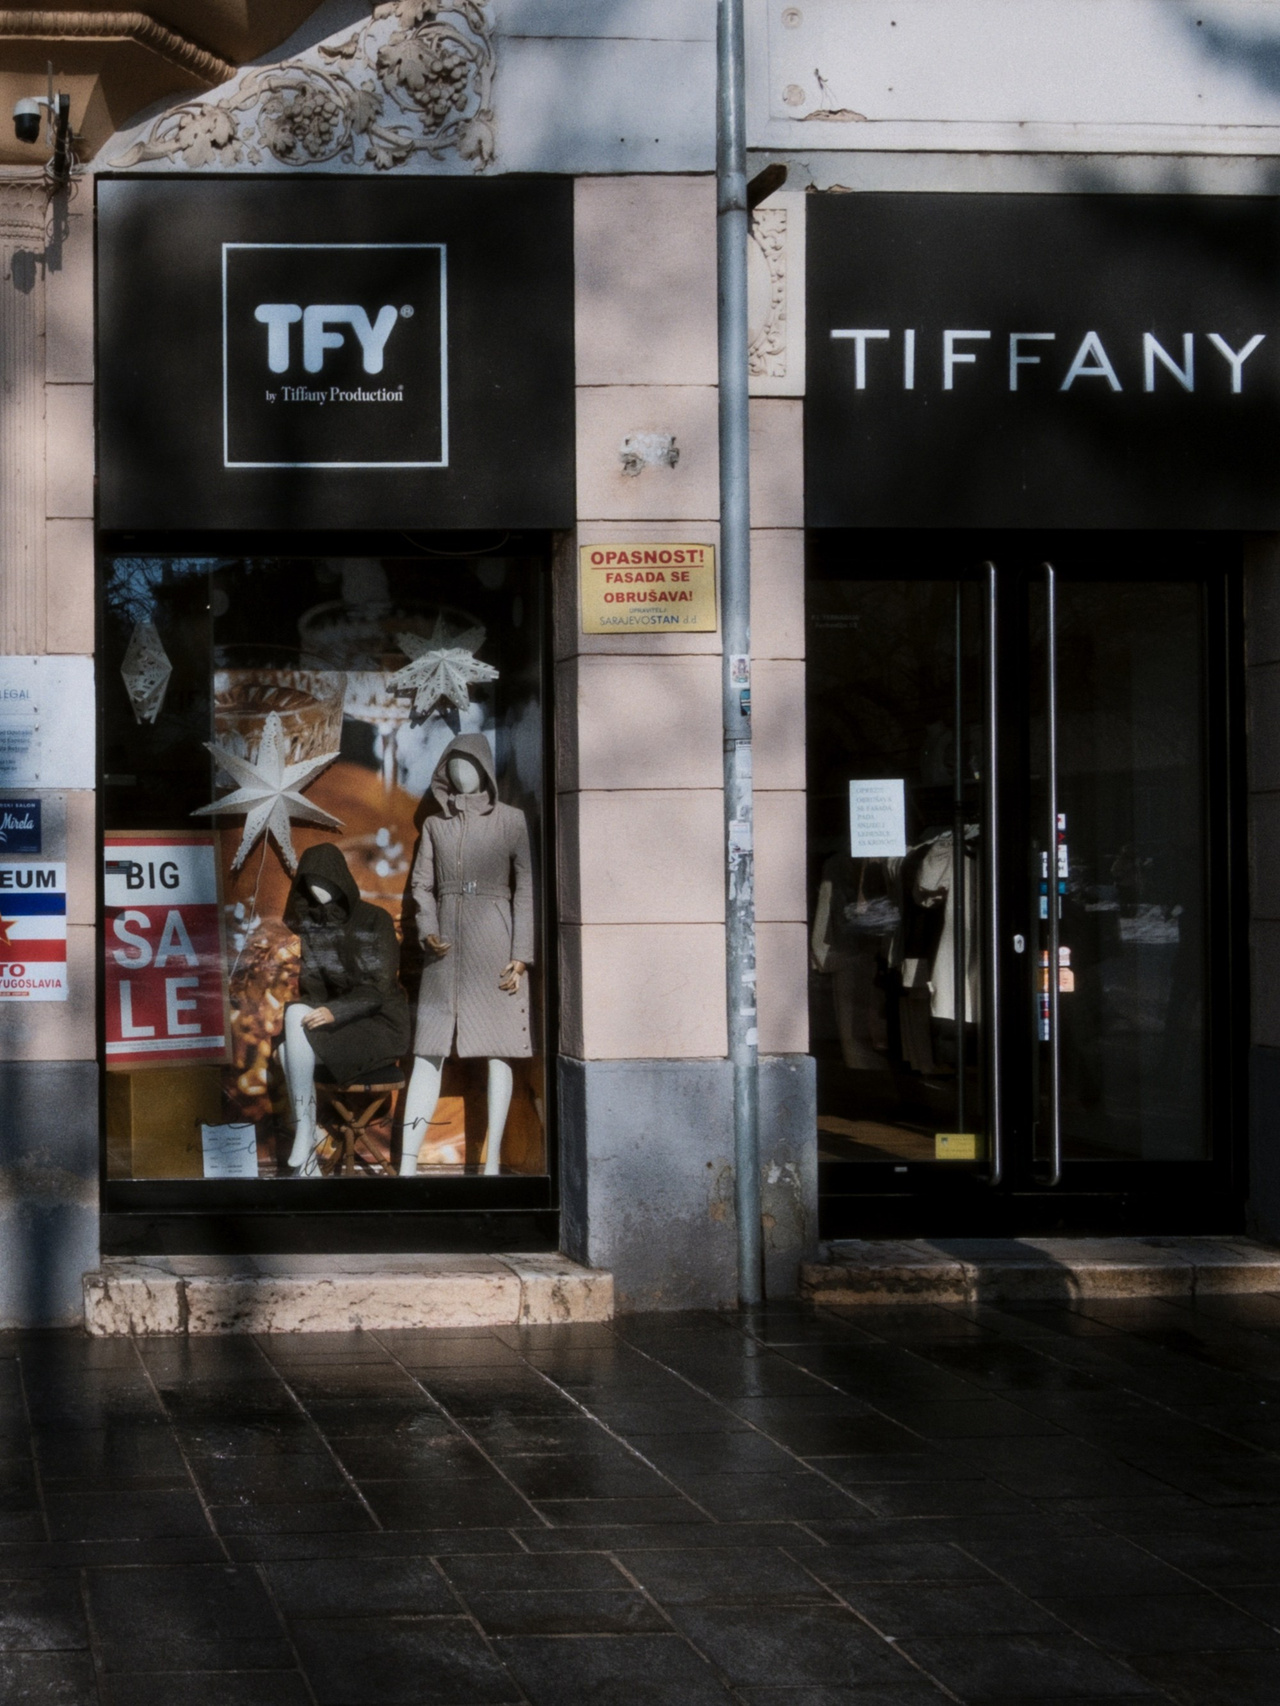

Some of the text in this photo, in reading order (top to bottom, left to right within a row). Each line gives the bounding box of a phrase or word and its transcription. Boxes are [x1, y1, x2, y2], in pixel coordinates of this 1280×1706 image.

[830, 329, 1267, 395] TIFFANY
[266, 386, 404, 405] by Tiffany Production
[590, 549, 704, 565] OPASNOST!
[605, 571, 690, 583] FASADA SE
[603, 589, 693, 603] OBRUŠAVA!
[599, 615, 679, 626] SARAJEVOSTAN
[0, 812, 35, 830] Mirela
[126, 861, 180, 890] BIG
